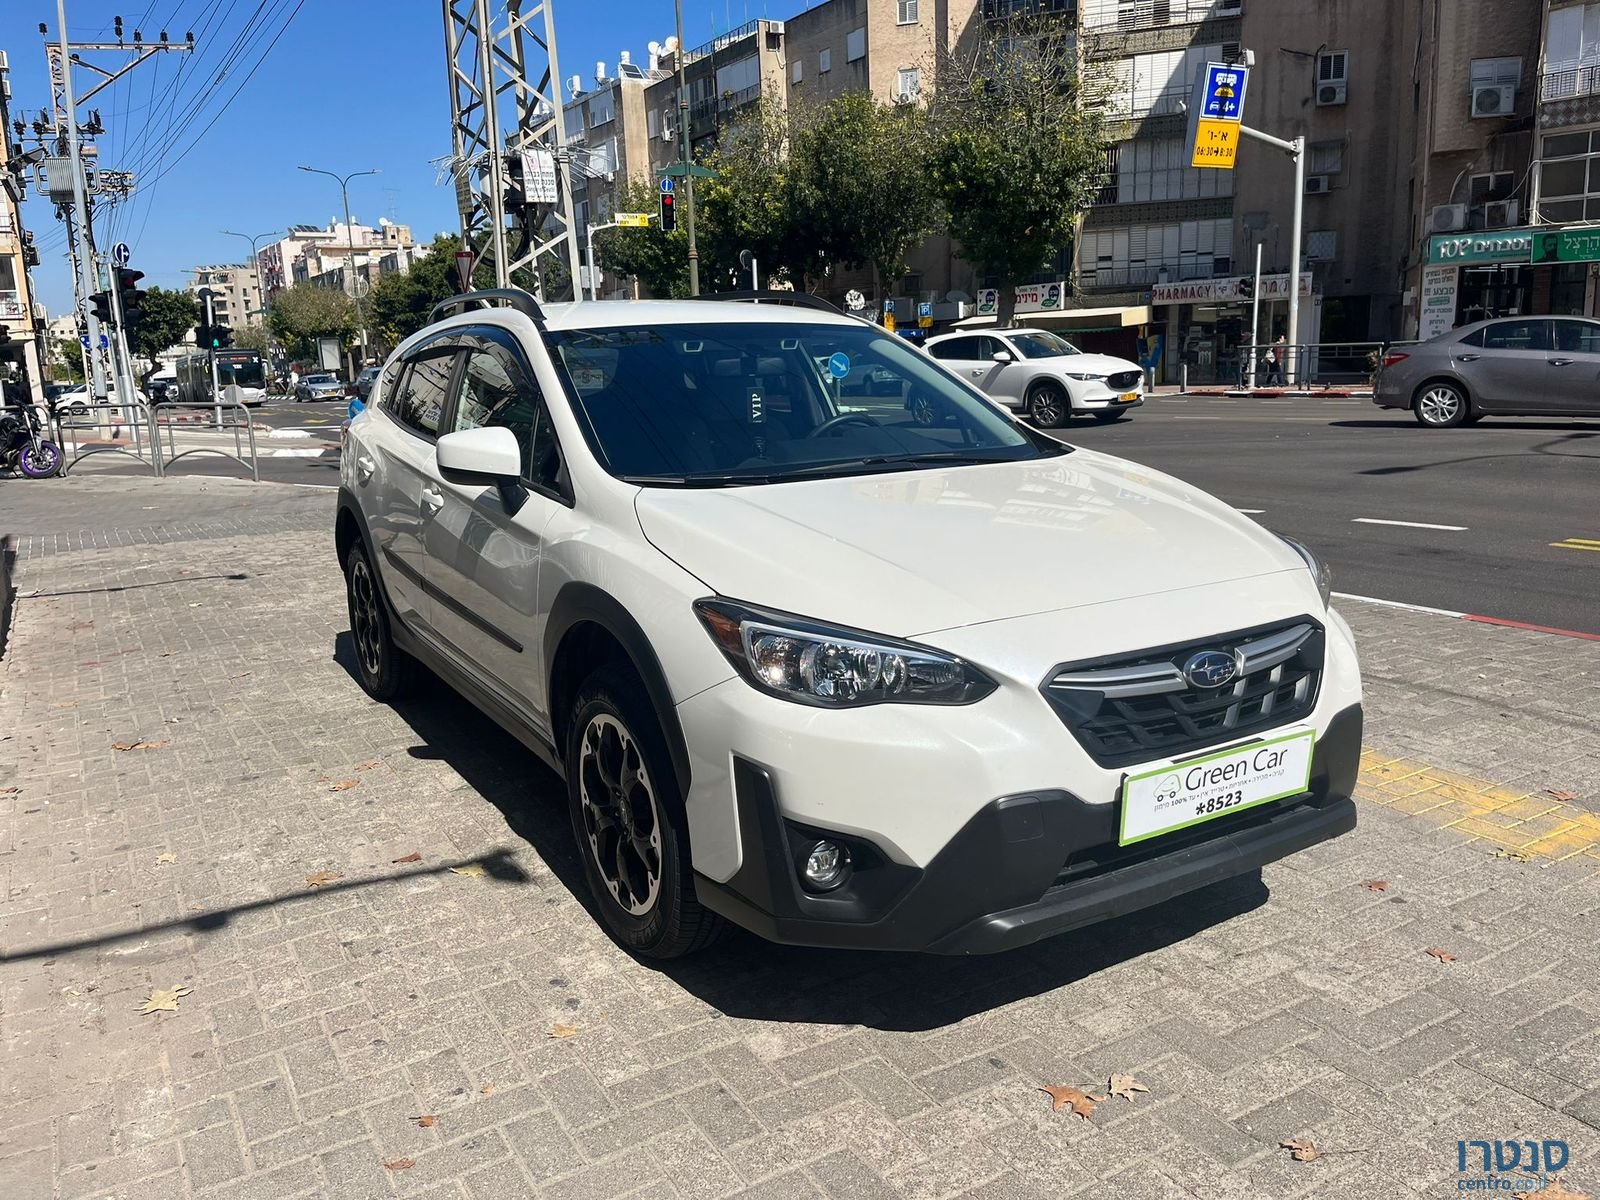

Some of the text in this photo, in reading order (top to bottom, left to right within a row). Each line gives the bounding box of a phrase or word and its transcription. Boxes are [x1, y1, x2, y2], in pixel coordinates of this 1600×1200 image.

[1152, 285, 1212, 301] PHARMACY
[752, 393, 762, 419] VIP
[1185, 748, 1288, 791] Green Car
[1171, 797, 1188, 807] 100%
